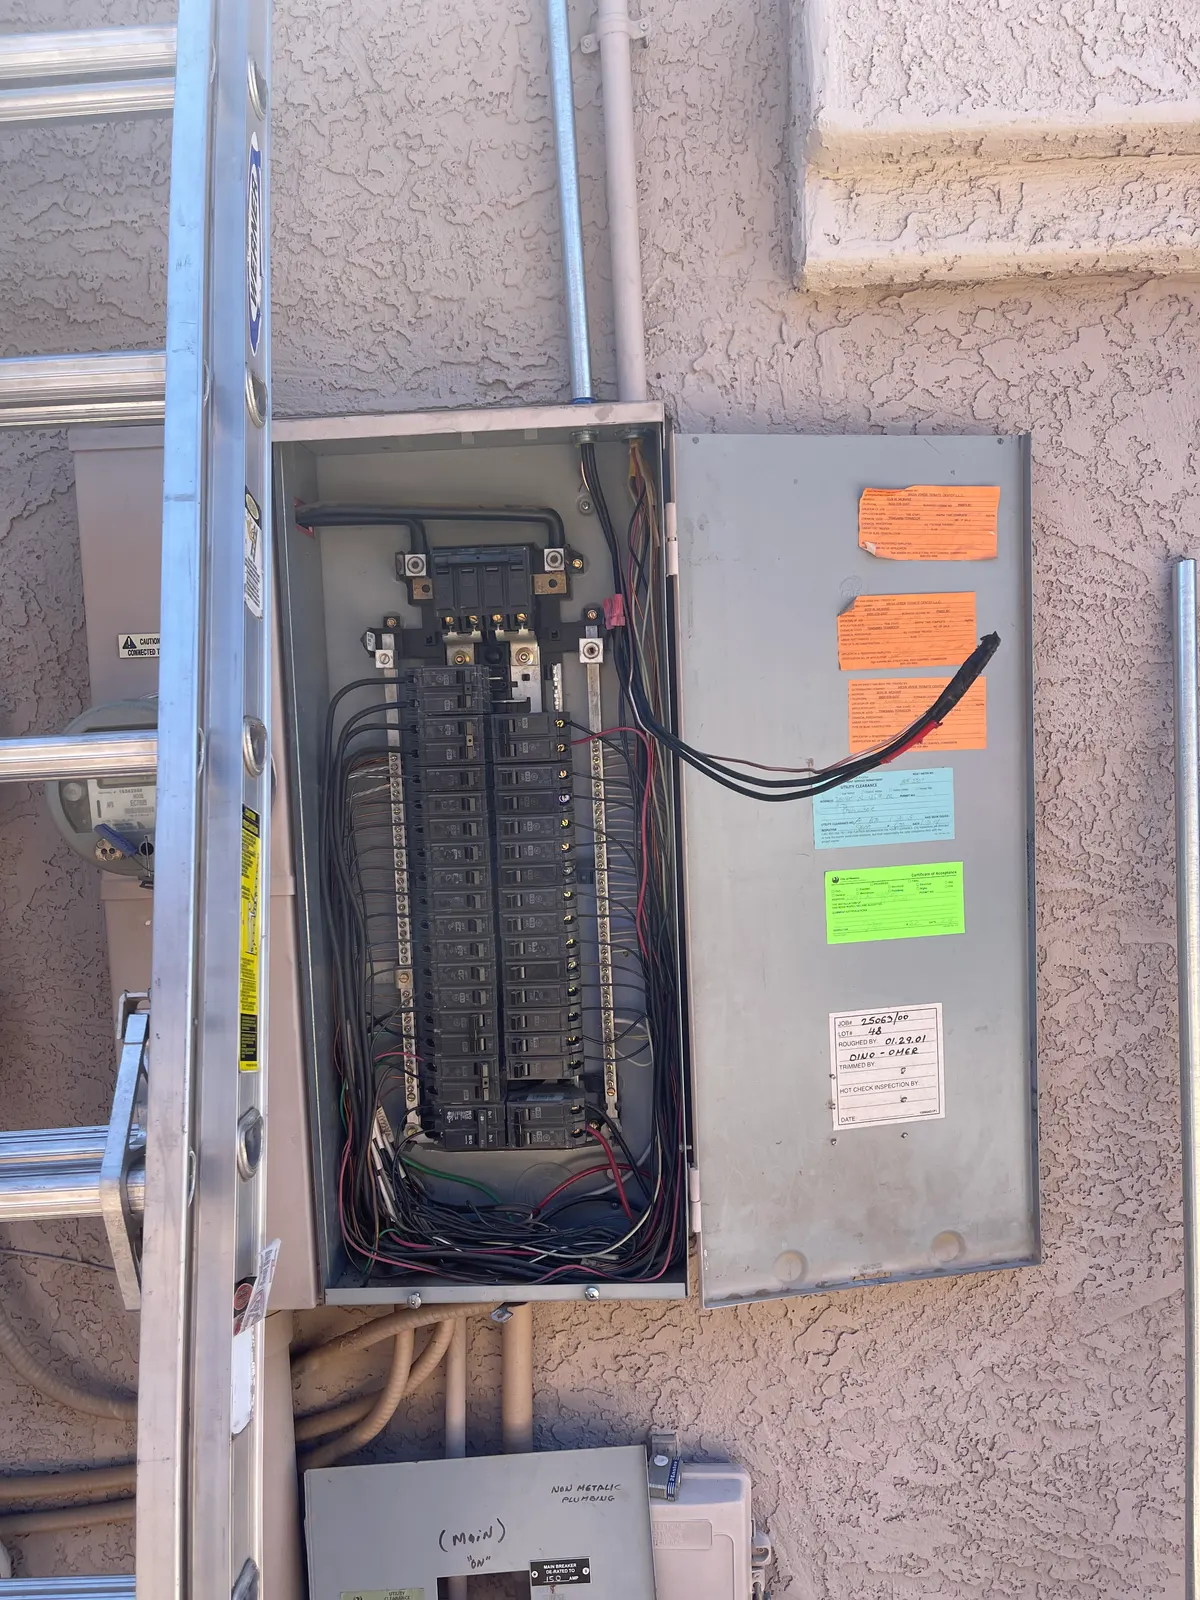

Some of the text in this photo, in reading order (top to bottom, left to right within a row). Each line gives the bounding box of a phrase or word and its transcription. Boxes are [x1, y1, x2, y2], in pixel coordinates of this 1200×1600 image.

[250, 173, 258, 307] WERNER
[868, 1026, 882, 1036] 48
[838, 1040, 868, 1048] ROUGHED
[885, 1035, 926, 1046] 01.29.01
[849, 1052, 876, 1062] DINO
[888, 1047, 918, 1056] OMER
[839, 1062, 866, 1070] TRIMMED
[854, 1085, 874, 1093] CHECK
[874, 1082, 910, 1091] INSPECTION
[551, 1486, 573, 1494] NON
